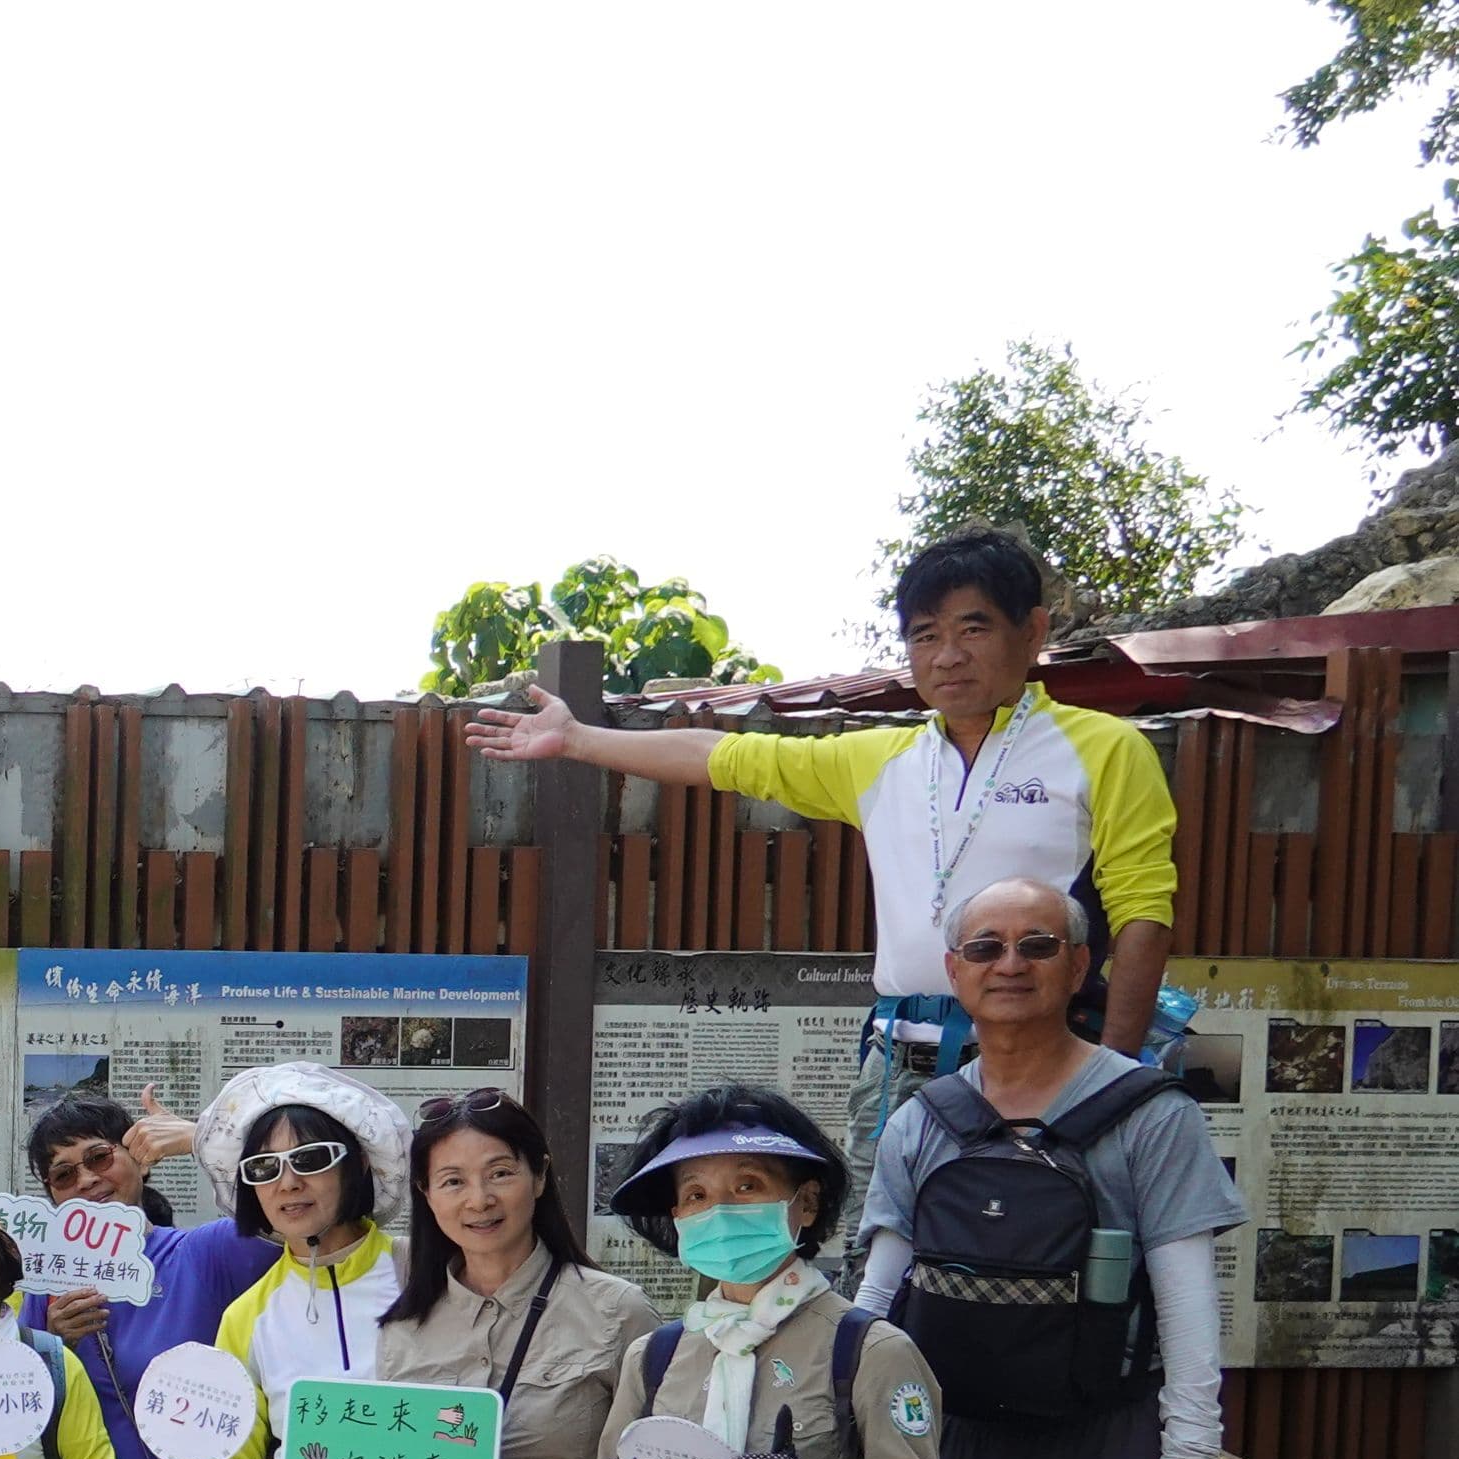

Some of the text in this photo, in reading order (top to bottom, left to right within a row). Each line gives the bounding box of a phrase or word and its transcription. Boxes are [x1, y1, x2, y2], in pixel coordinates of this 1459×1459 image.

[797, 967, 840, 983] Cultural
[221, 985, 520, 1003] Profuse Life & Sustainable Marine Development
[1398, 996, 1443, 1008] From the
[63, 1208, 132, 1257] OUT
[24, 1251, 140, 1283] 護原生植物
[144, 1388, 241, 1438] 第2小隊
[296, 1396, 417, 1433] 移起來
